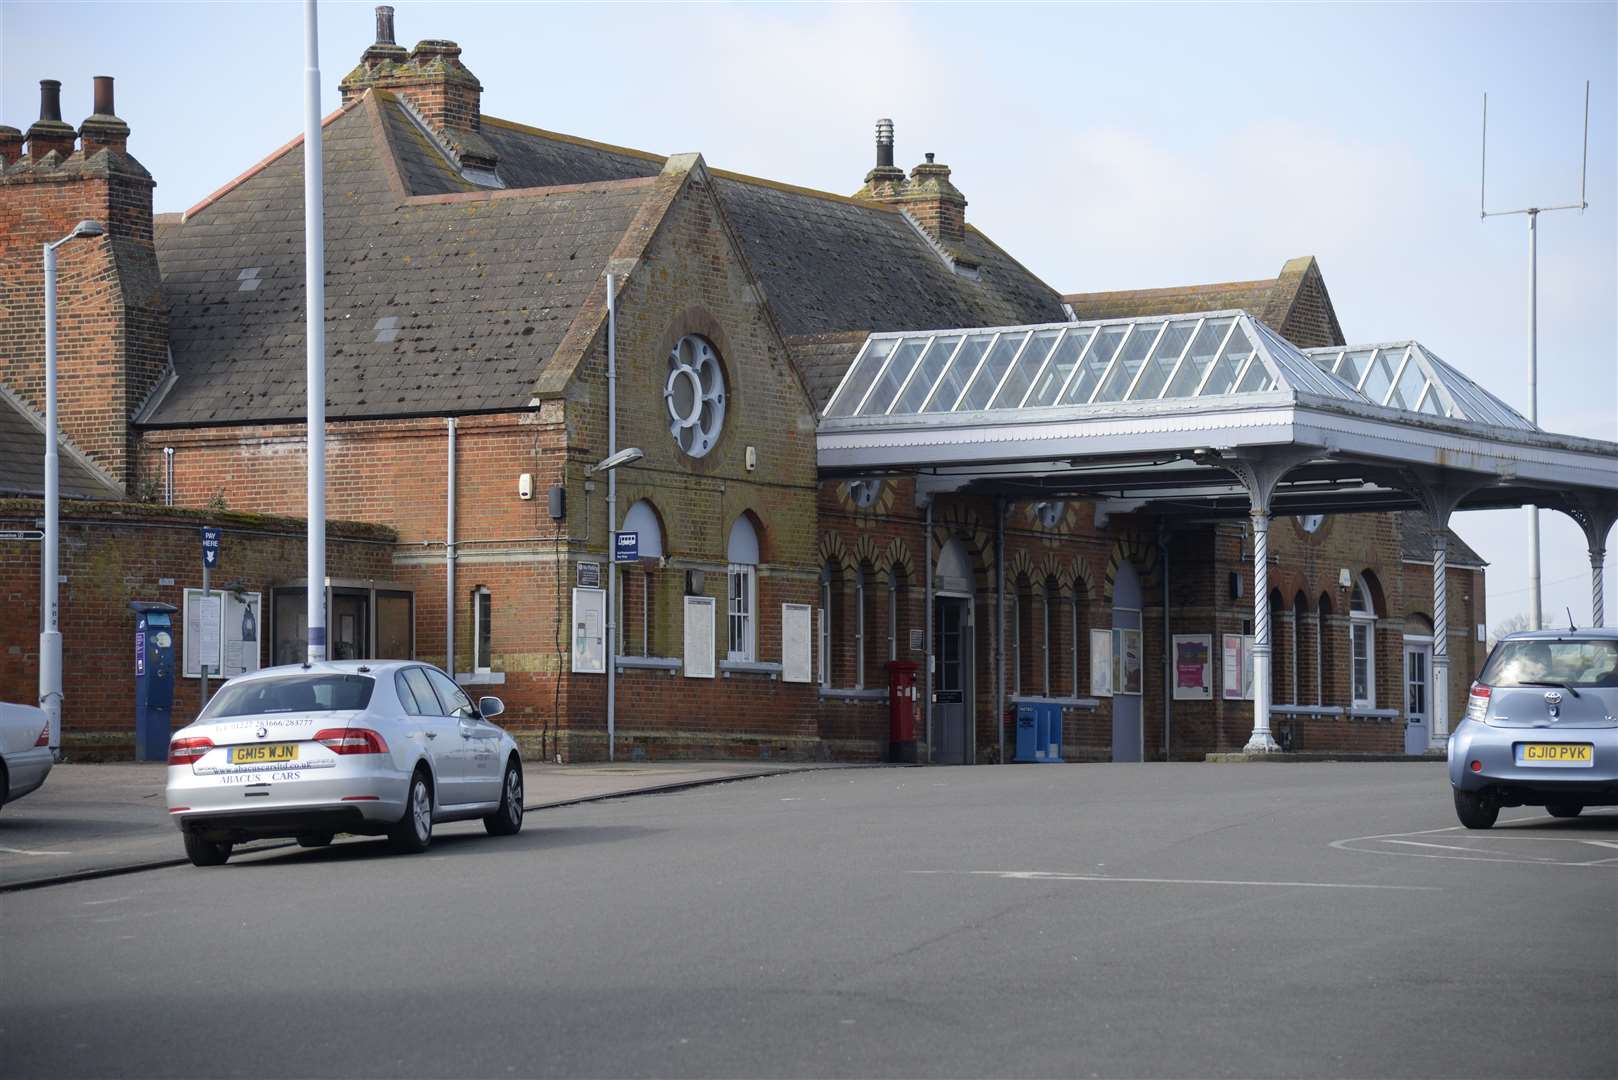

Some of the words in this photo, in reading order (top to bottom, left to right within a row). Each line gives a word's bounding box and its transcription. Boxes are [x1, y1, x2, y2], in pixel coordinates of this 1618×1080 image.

[237, 747, 265, 760] GM15
[268, 745, 294, 758] WJN
[1528, 747, 1557, 759] GJ10
[1560, 747, 1585, 759] PVK
[220, 773, 261, 785] ABACUS
[272, 771, 301, 782] CARS
